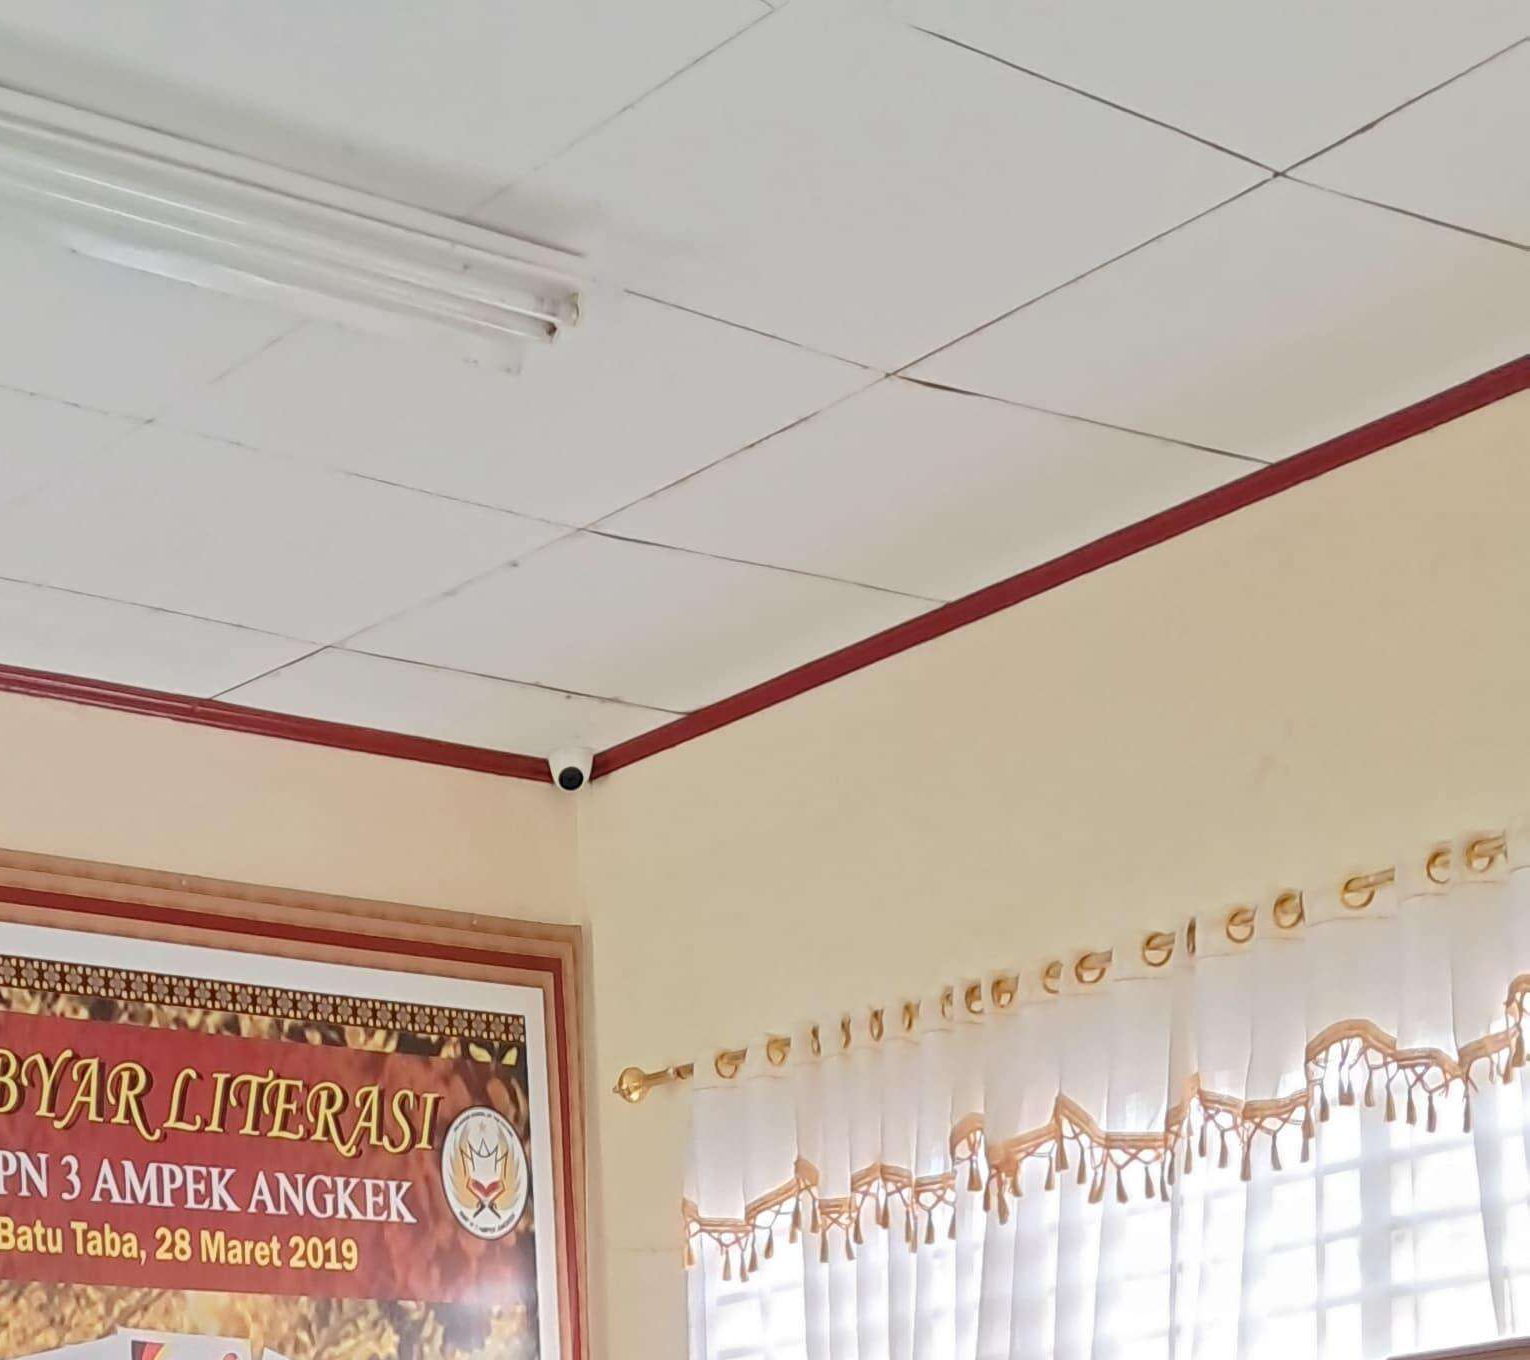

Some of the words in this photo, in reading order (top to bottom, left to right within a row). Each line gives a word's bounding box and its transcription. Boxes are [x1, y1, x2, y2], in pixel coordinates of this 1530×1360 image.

[163, 1067, 443, 1158] LITERASI
[60, 1154, 82, 1201] 3
[91, 1158, 241, 1212] AMPEK
[247, 1169, 418, 1224] ANGKEK
[70, 1220, 147, 1266] Taba,
[154, 1226, 192, 1262] 28
[199, 1229, 282, 1268] Maret
[288, 1235, 359, 1271] 2019
